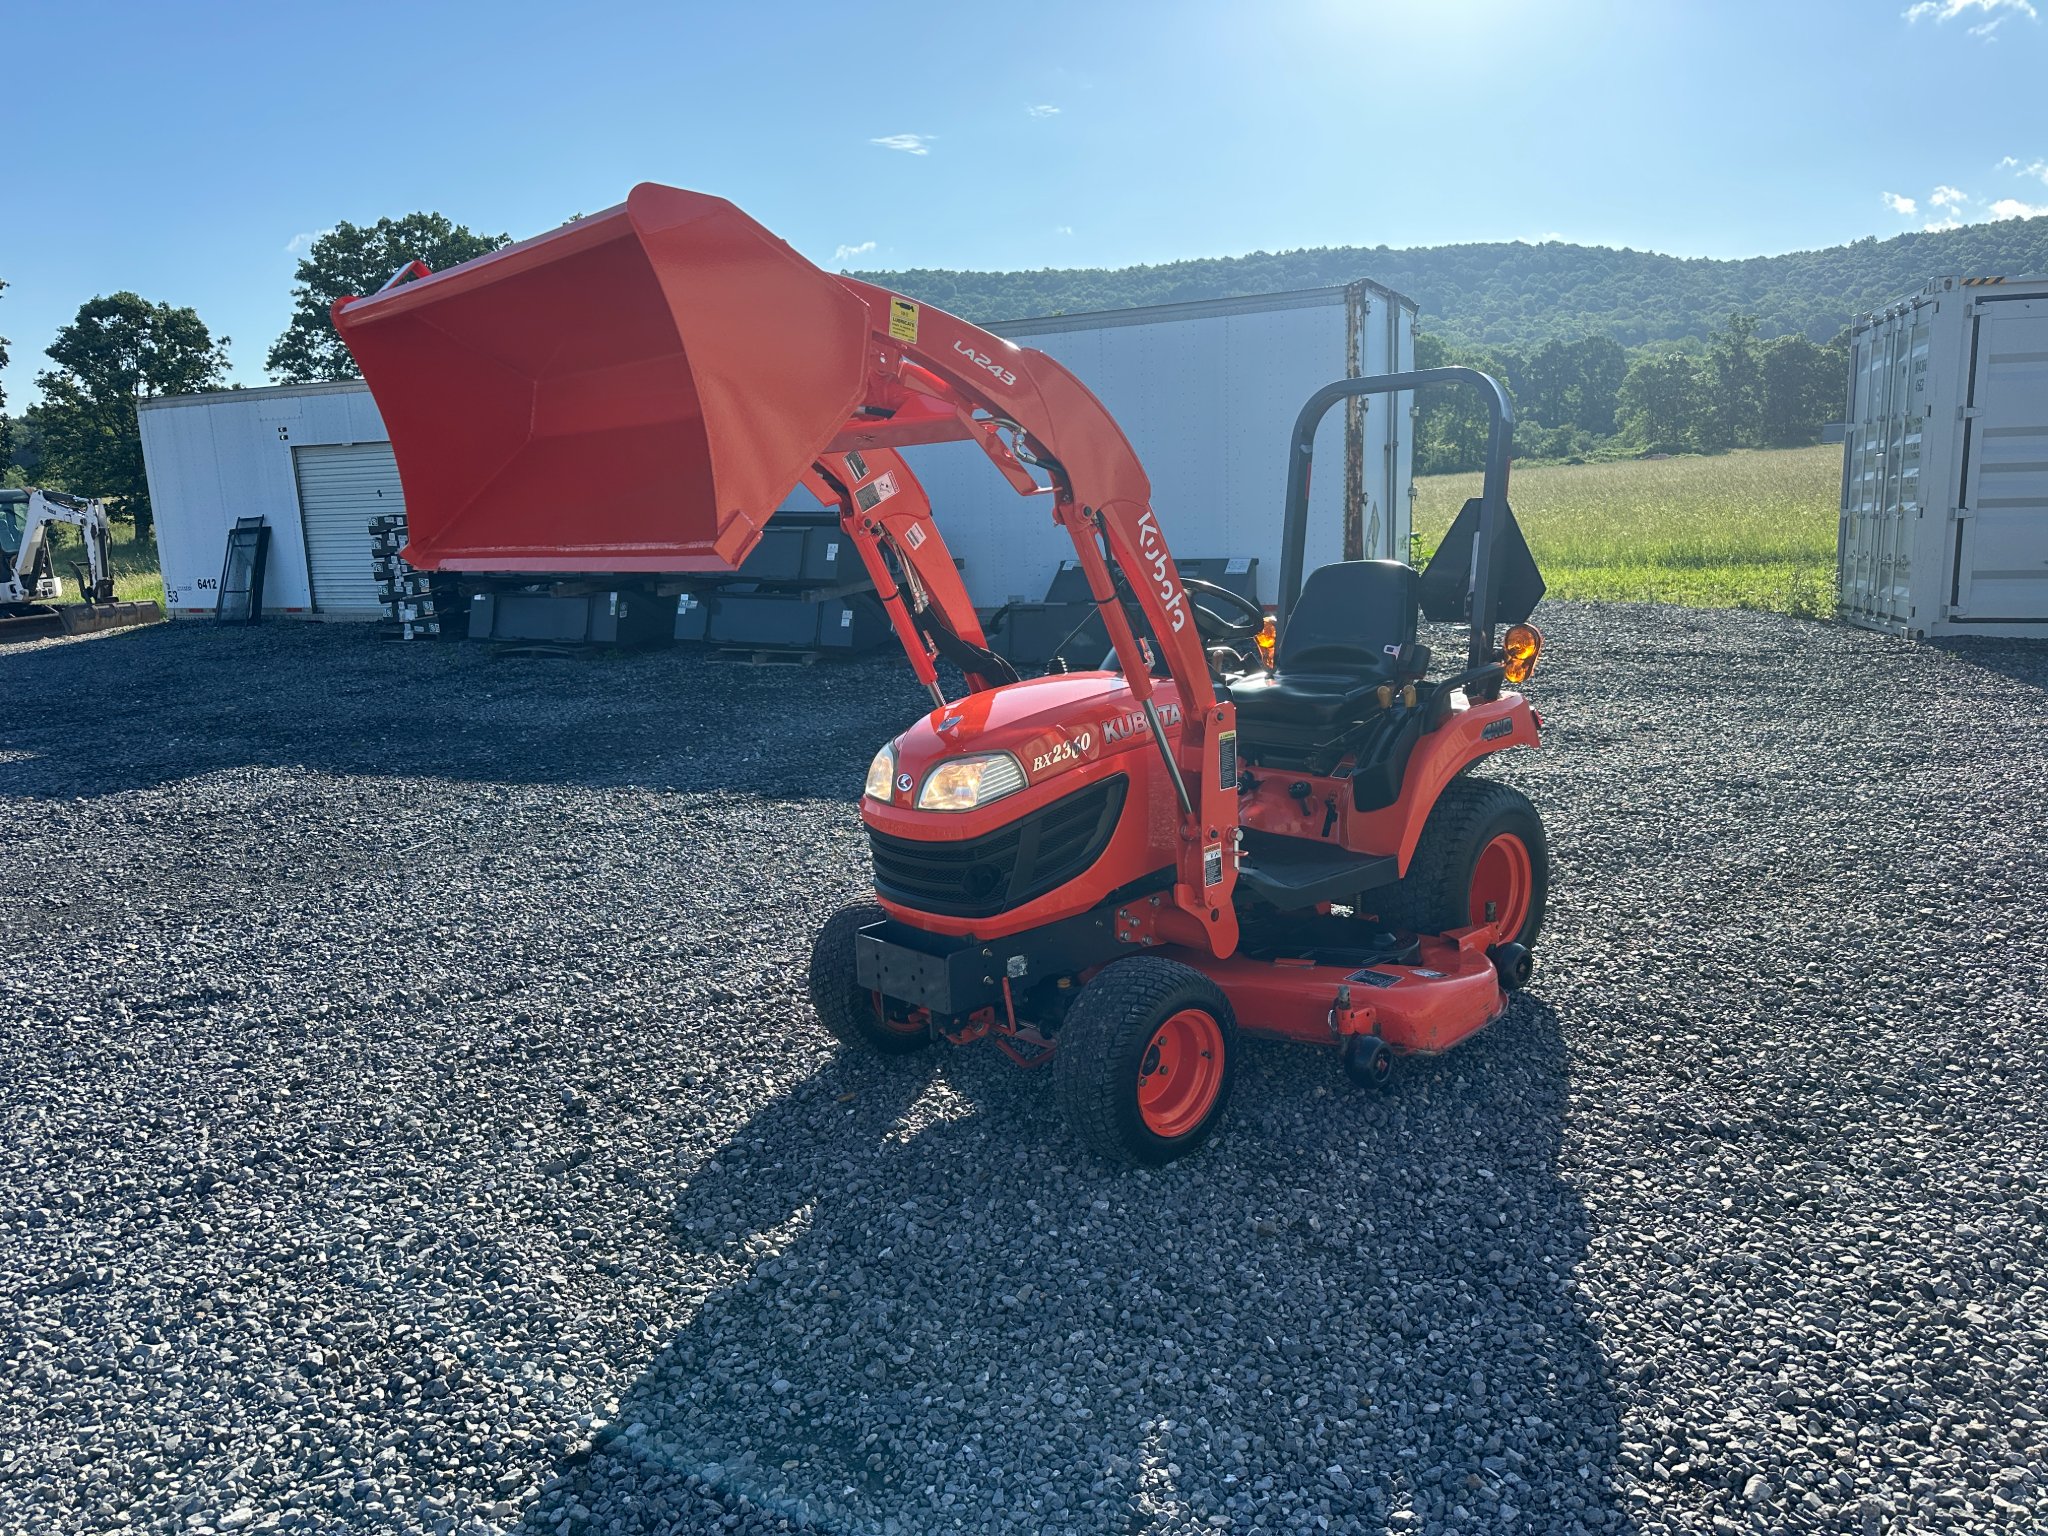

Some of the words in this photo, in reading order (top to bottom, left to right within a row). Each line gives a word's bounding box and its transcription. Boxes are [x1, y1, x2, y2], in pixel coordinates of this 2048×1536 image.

[953, 340, 1017, 386] LA243
[197, 578, 218, 590] 6412
[1137, 511, 1185, 633] Kubota
[167, 590, 179, 603] 53
